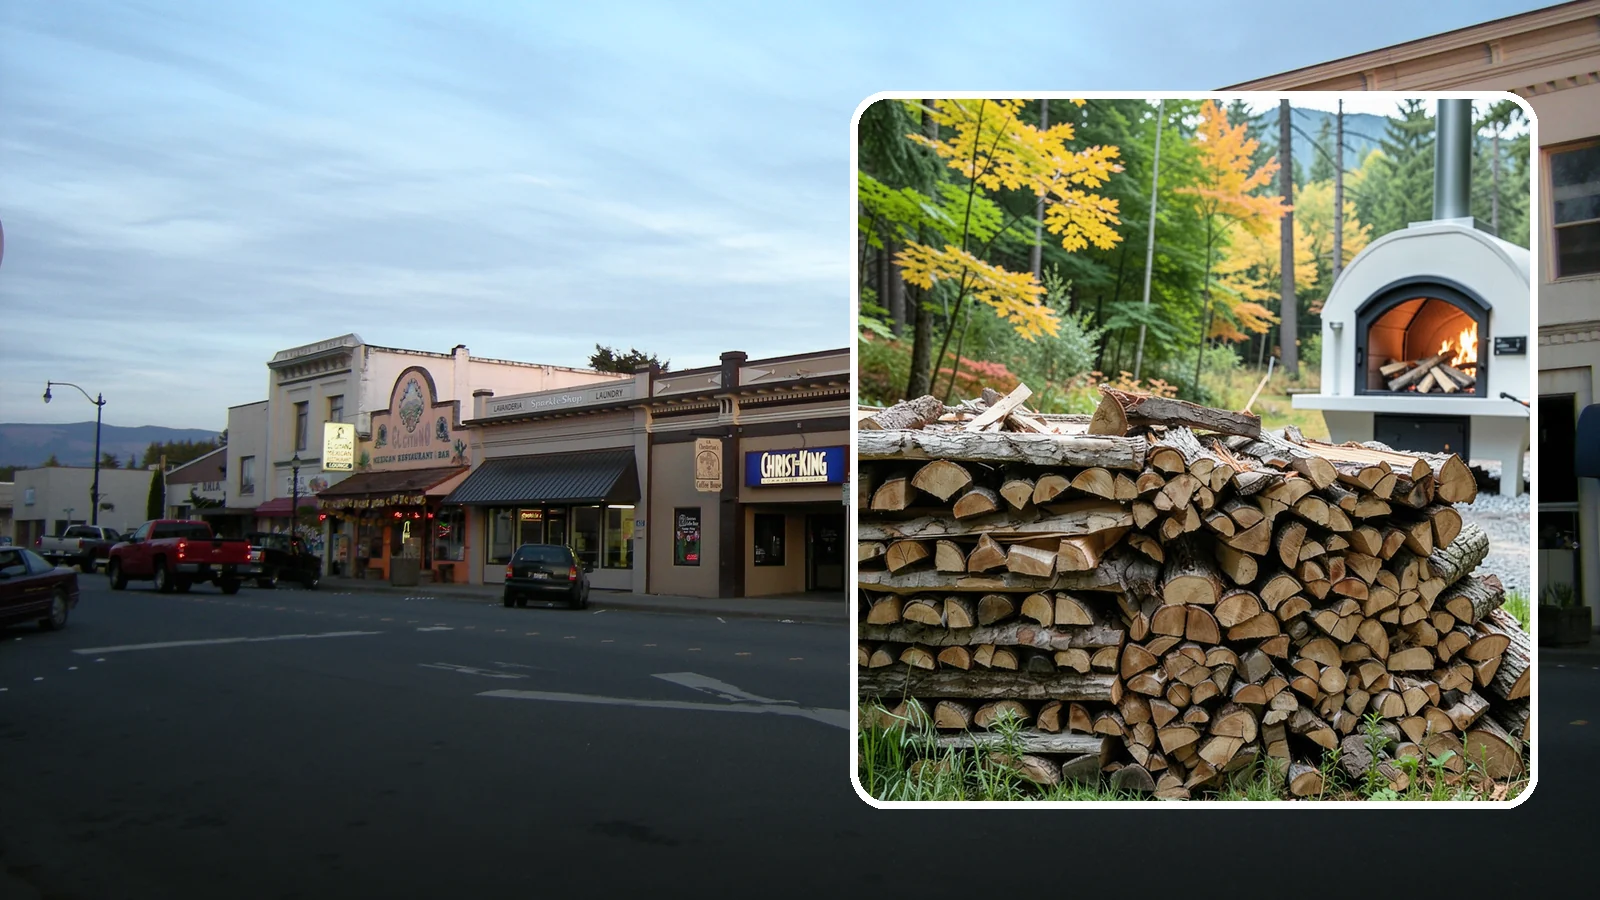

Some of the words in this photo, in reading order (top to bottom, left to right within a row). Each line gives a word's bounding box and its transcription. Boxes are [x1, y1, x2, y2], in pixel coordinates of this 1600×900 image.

[561, 394, 582, 406] Shop
[595, 389, 624, 400] LAUNDRY
[493, 402, 522, 412] LAVANDERIA
[373, 455, 396, 464] MEXICAN
[397, 451, 434, 462] RESTAURANT
[437, 450, 450, 459] BAR
